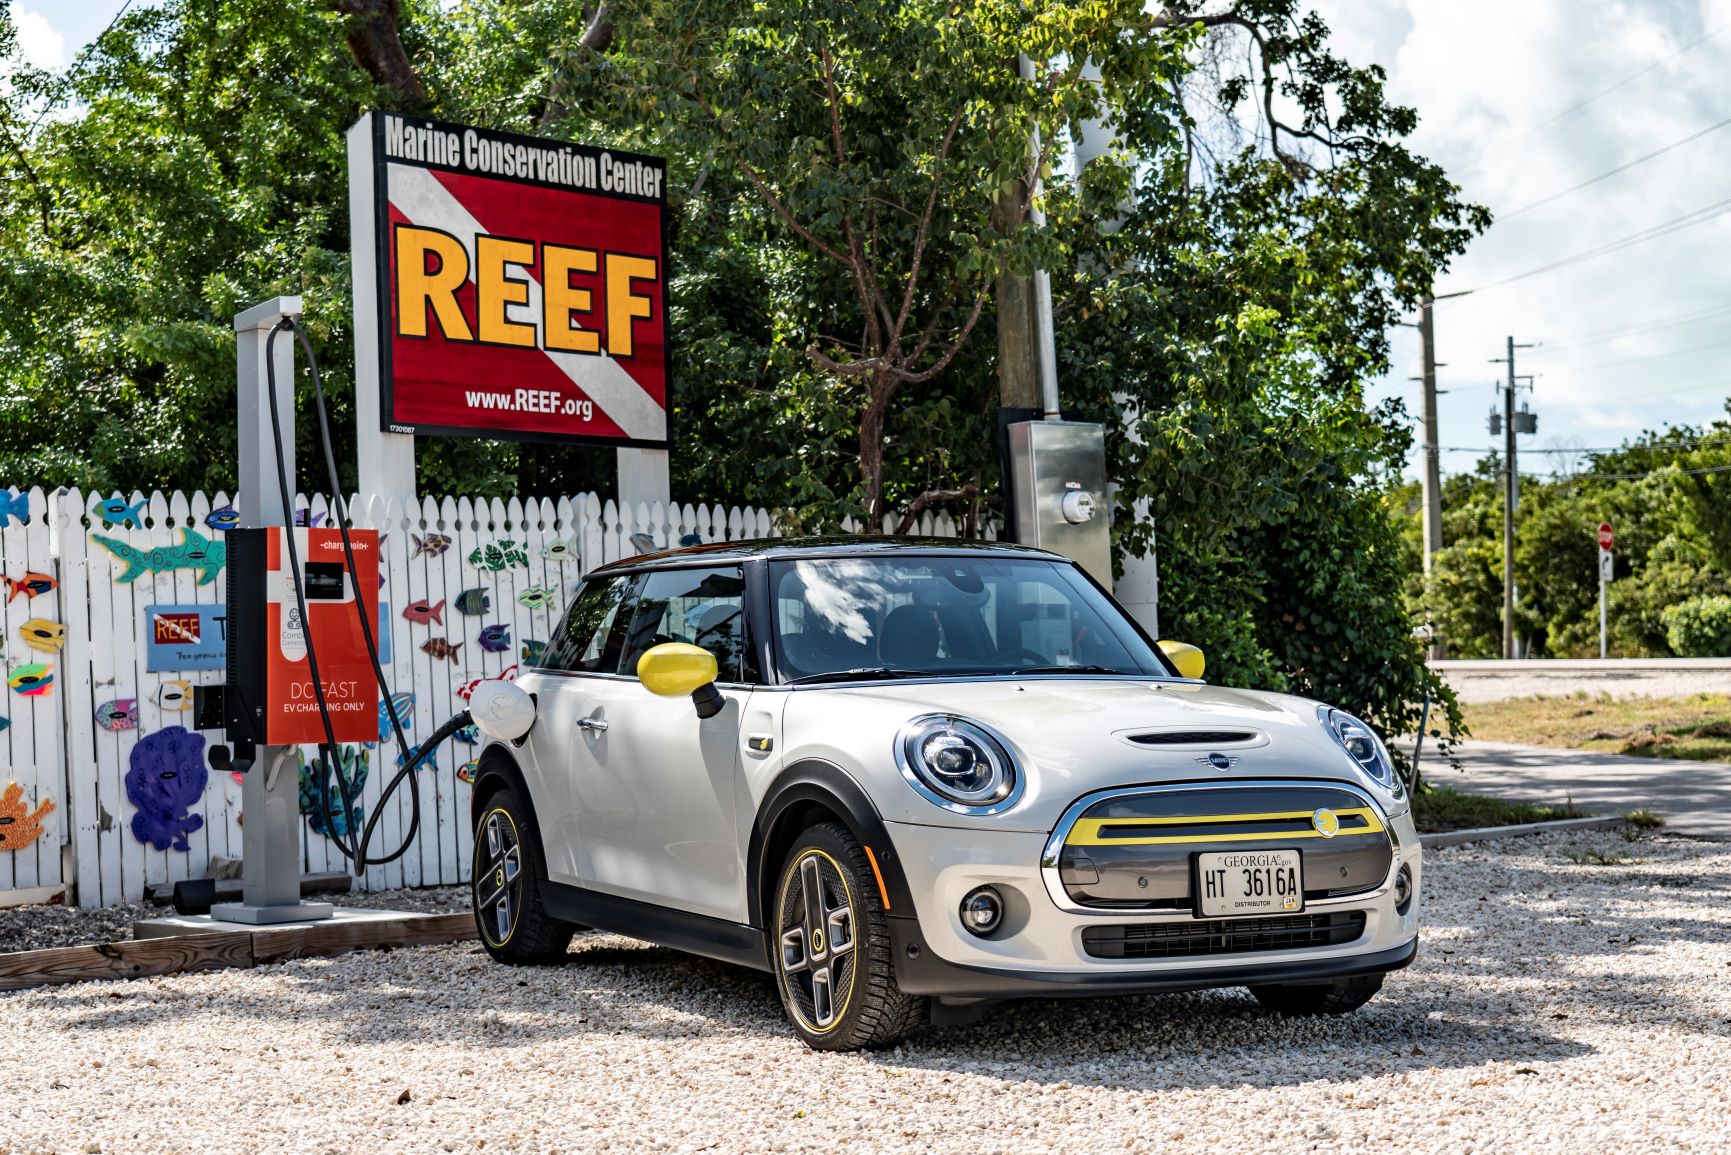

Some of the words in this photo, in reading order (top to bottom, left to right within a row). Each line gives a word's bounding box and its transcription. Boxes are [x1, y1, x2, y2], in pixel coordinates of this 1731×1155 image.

[384, 115, 460, 168] Marine
[464, 129, 597, 189] Conservation
[599, 152, 663, 199] Center
[394, 222, 658, 358] REEF
[465, 388, 593, 422] www.REEF.org
[156, 618, 199, 640] REEF
[282, 631, 304, 640] Comb
[291, 682, 314, 699] DC
[283, 703, 295, 713] EV
[296, 702, 341, 713] CHARING
[343, 702, 365, 712] ONLY
[1205, 869, 1226, 898] HT
[1242, 867, 1297, 897] 3616A
[1234, 900, 1271, 908] DISTRIBUTOR
